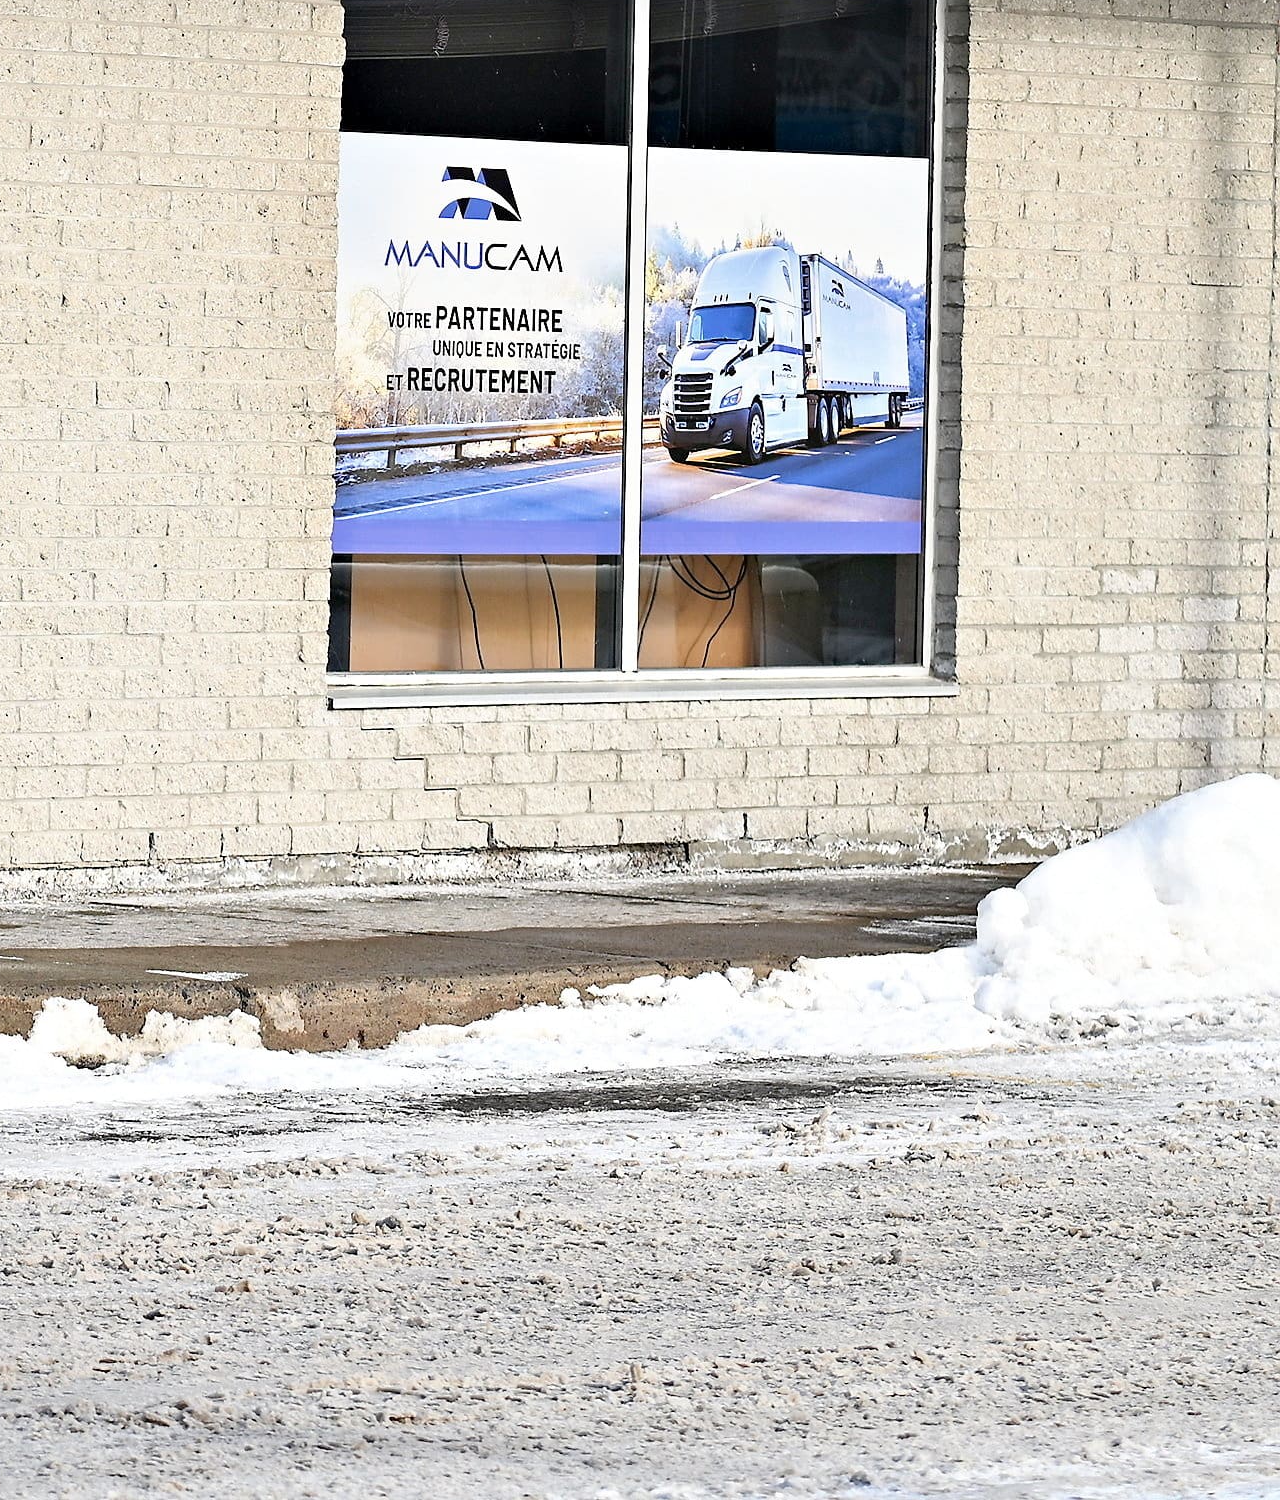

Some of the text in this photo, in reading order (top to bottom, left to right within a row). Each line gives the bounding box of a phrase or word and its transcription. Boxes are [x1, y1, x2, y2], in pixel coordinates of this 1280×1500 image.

[384, 239, 564, 272] MANUCAM
[388, 305, 563, 333] VOTRE PARTENAIRE
[432, 339, 581, 360] UNIQUE EN STRATÉGIE
[386, 367, 557, 394] ET RECRUTEMENT
